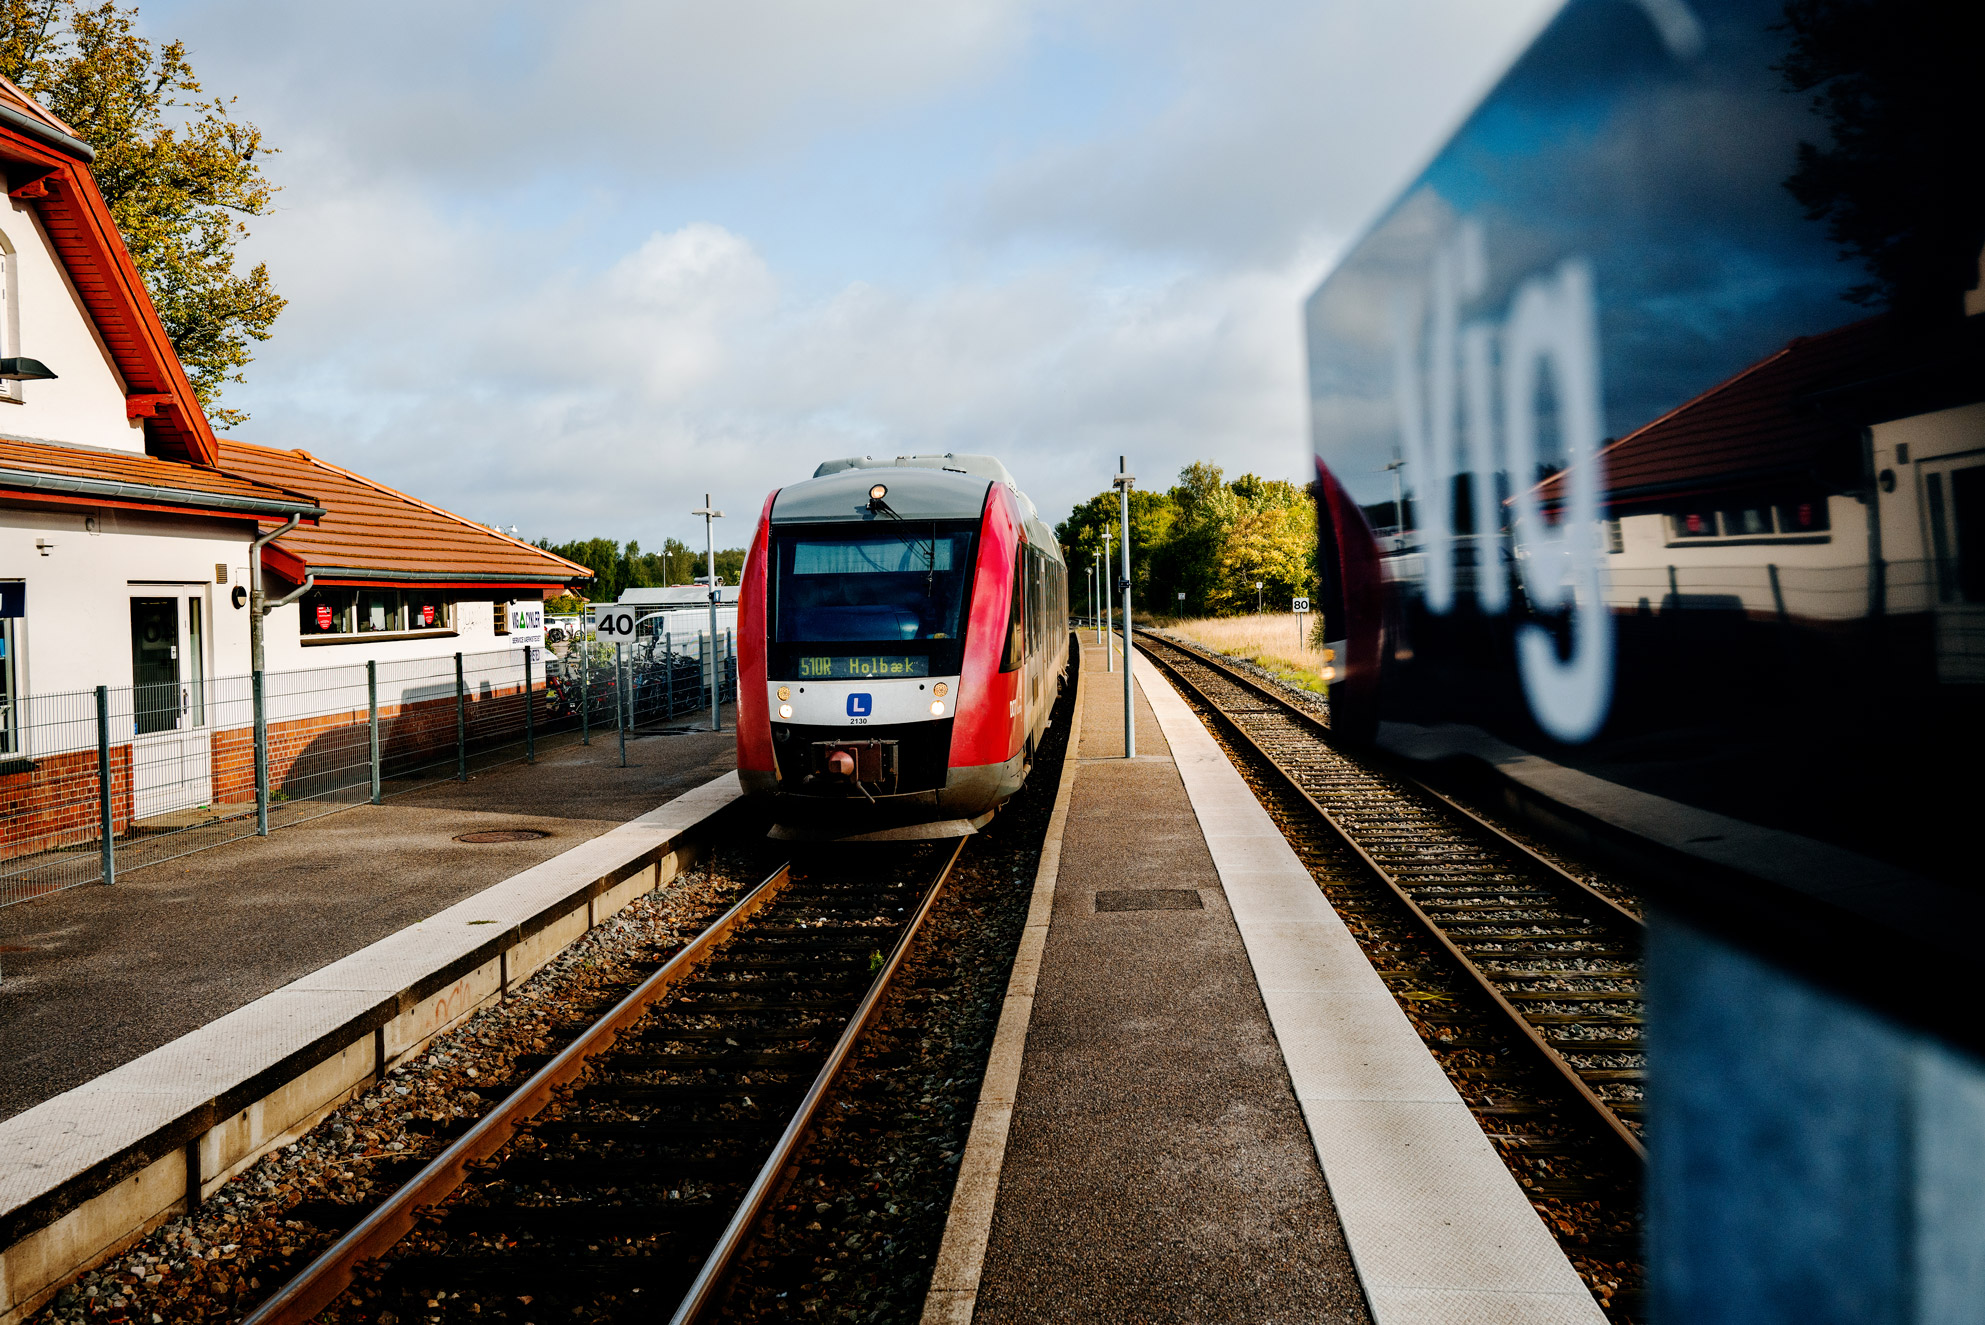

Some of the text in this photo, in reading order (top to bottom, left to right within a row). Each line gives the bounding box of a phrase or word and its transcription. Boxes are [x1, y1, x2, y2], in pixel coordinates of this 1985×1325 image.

[1395, 215, 1618, 745] Vig
[1294, 600, 1308, 610] 80
[598, 614, 634, 635] 40
[801, 657, 914, 676] 510R Holbæk
[853, 697, 865, 712] L
